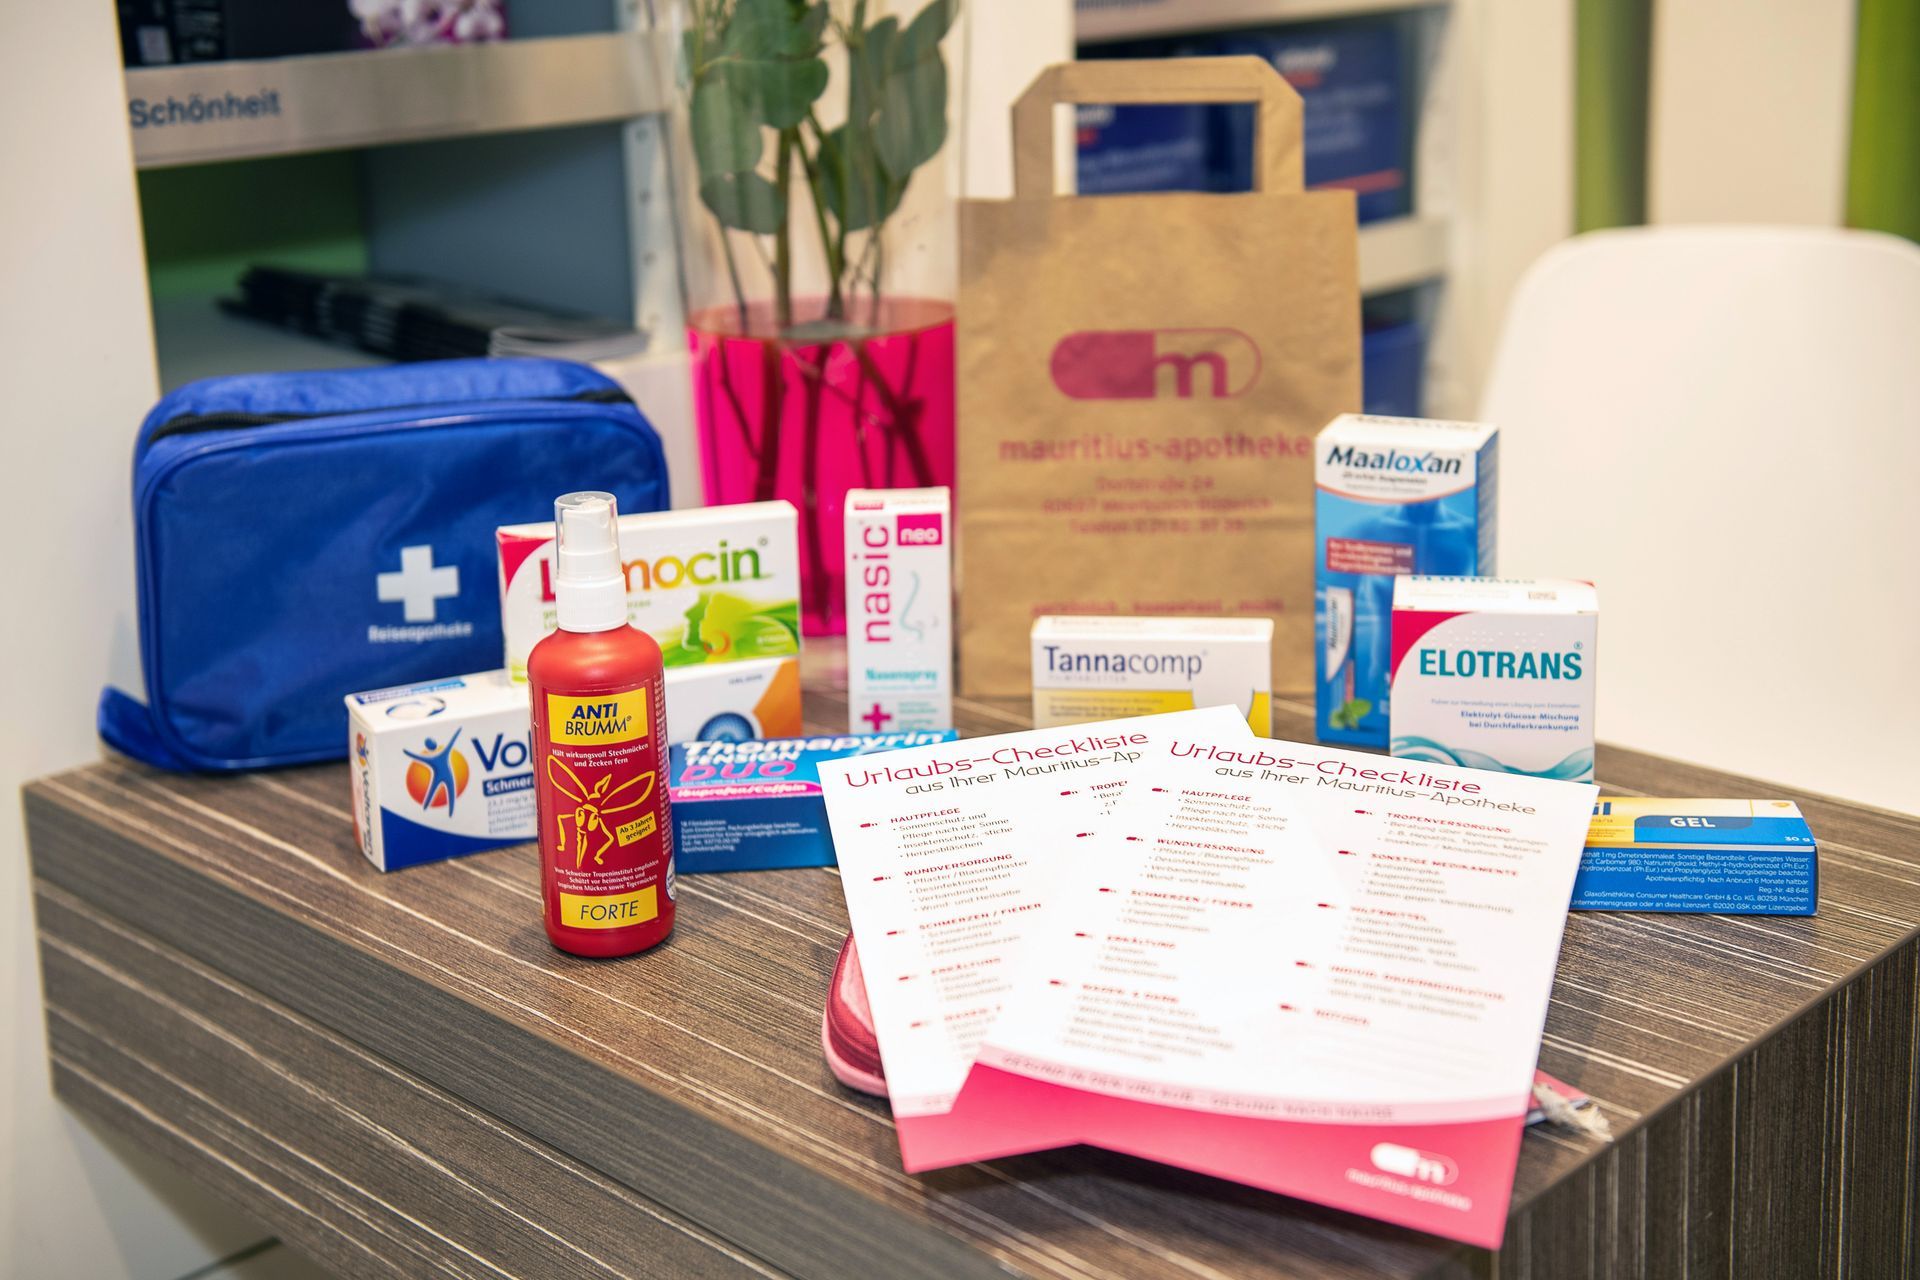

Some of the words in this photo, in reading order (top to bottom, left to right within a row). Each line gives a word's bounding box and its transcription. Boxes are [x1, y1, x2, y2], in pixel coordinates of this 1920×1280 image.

[129, 88, 282, 129] Schönheit
[999, 432, 1313, 463] mauritius-apotheke
[1326, 445, 1462, 475] Maaloxan
[901, 528, 940, 544] neo
[540, 536, 768, 603] Lmocin®
[853, 526, 891, 643] nasic
[367, 622, 473, 644] Reiseapotheke
[1043, 645, 1203, 681] Tannacomp
[571, 703, 618, 719] ANTI
[1484, 722, 1580, 732] Durchfallerkrankungen
[470, 730, 534, 773] Vol
[552, 748, 564, 757] Hält
[566, 751, 607, 759] wirkungsvoll
[608, 743, 649, 757] Stechmücken
[682, 733, 944, 758] Thomapyrin
[614, 757, 628, 765] fern
[685, 750, 801, 766] TENSION
[845, 731, 1150, 788] Urlaubs-Checkliste
[1170, 740, 1482, 795] Urlaubs-Checkliste
[679, 760, 797, 782] DUO
[905, 780, 944, 796] aus
[949, 772, 996, 788] Ihrer
[1004, 751, 1144, 778] Mauritius-Ap
[486, 775, 534, 794] Schmer
[1089, 781, 1128, 791] TROPE
[1215, 765, 1253, 779] aus
[1260, 769, 1310, 785] Ihrer
[1316, 776, 1537, 817] Mauritius-Apotheke
[1181, 789, 1252, 802] HAUTPFLEGE
[1184, 797, 1251, 811] Sonnenschutz
[634, 816, 653, 830] Jahren
[890, 807, 961, 824] HAUTPFLEGE
[899, 816, 966, 832] Sonnenschutz
[968, 812, 987, 821] und
[1180, 806, 1210, 815] Pflege
[1257, 815, 1288, 823] Sonne
[1386, 812, 1512, 834] TROPENVERSORGUNG
[1669, 816, 1717, 828] GEL
[625, 825, 651, 841] geeignet
[902, 830, 933, 841] Pflege
[935, 826, 959, 836] nach
[960, 823, 976, 831] der
[979, 818, 1009, 828] Sonne
[1171, 822, 1248, 836] Herpesbläschen
[905, 840, 983, 859] Herpesbläschen
[1157, 838, 1265, 855] WUNDVERSORGUNG
[903, 853, 1013, 877] WUNDVERSORGUNG
[1677, 853, 1705, 861] Sonstige
[1748, 855, 1784, 863] Gereinigtes
[1699, 861, 1780, 869] Methyl-4-hydroxybenzoat
[565, 869, 591, 877] Schweizer
[593, 867, 633, 878] Tropeninstitut
[634, 859, 659, 873] empfohlen
[602, 874, 634, 884] heimischen
[635, 871, 645, 880] und
[1580, 865, 1632, 873] -hydroxybenzoat
[1723, 868, 1777, 876] Packungsbeilage
[558, 881, 583, 890] tropischen
[609, 883, 625, 891] sowie
[627, 874, 658, 888] Tigermücken
[913, 873, 951, 885] Pflaster
[915, 872, 1012, 894] Desinfektionsmittel
[580, 900, 639, 921] FORTE
